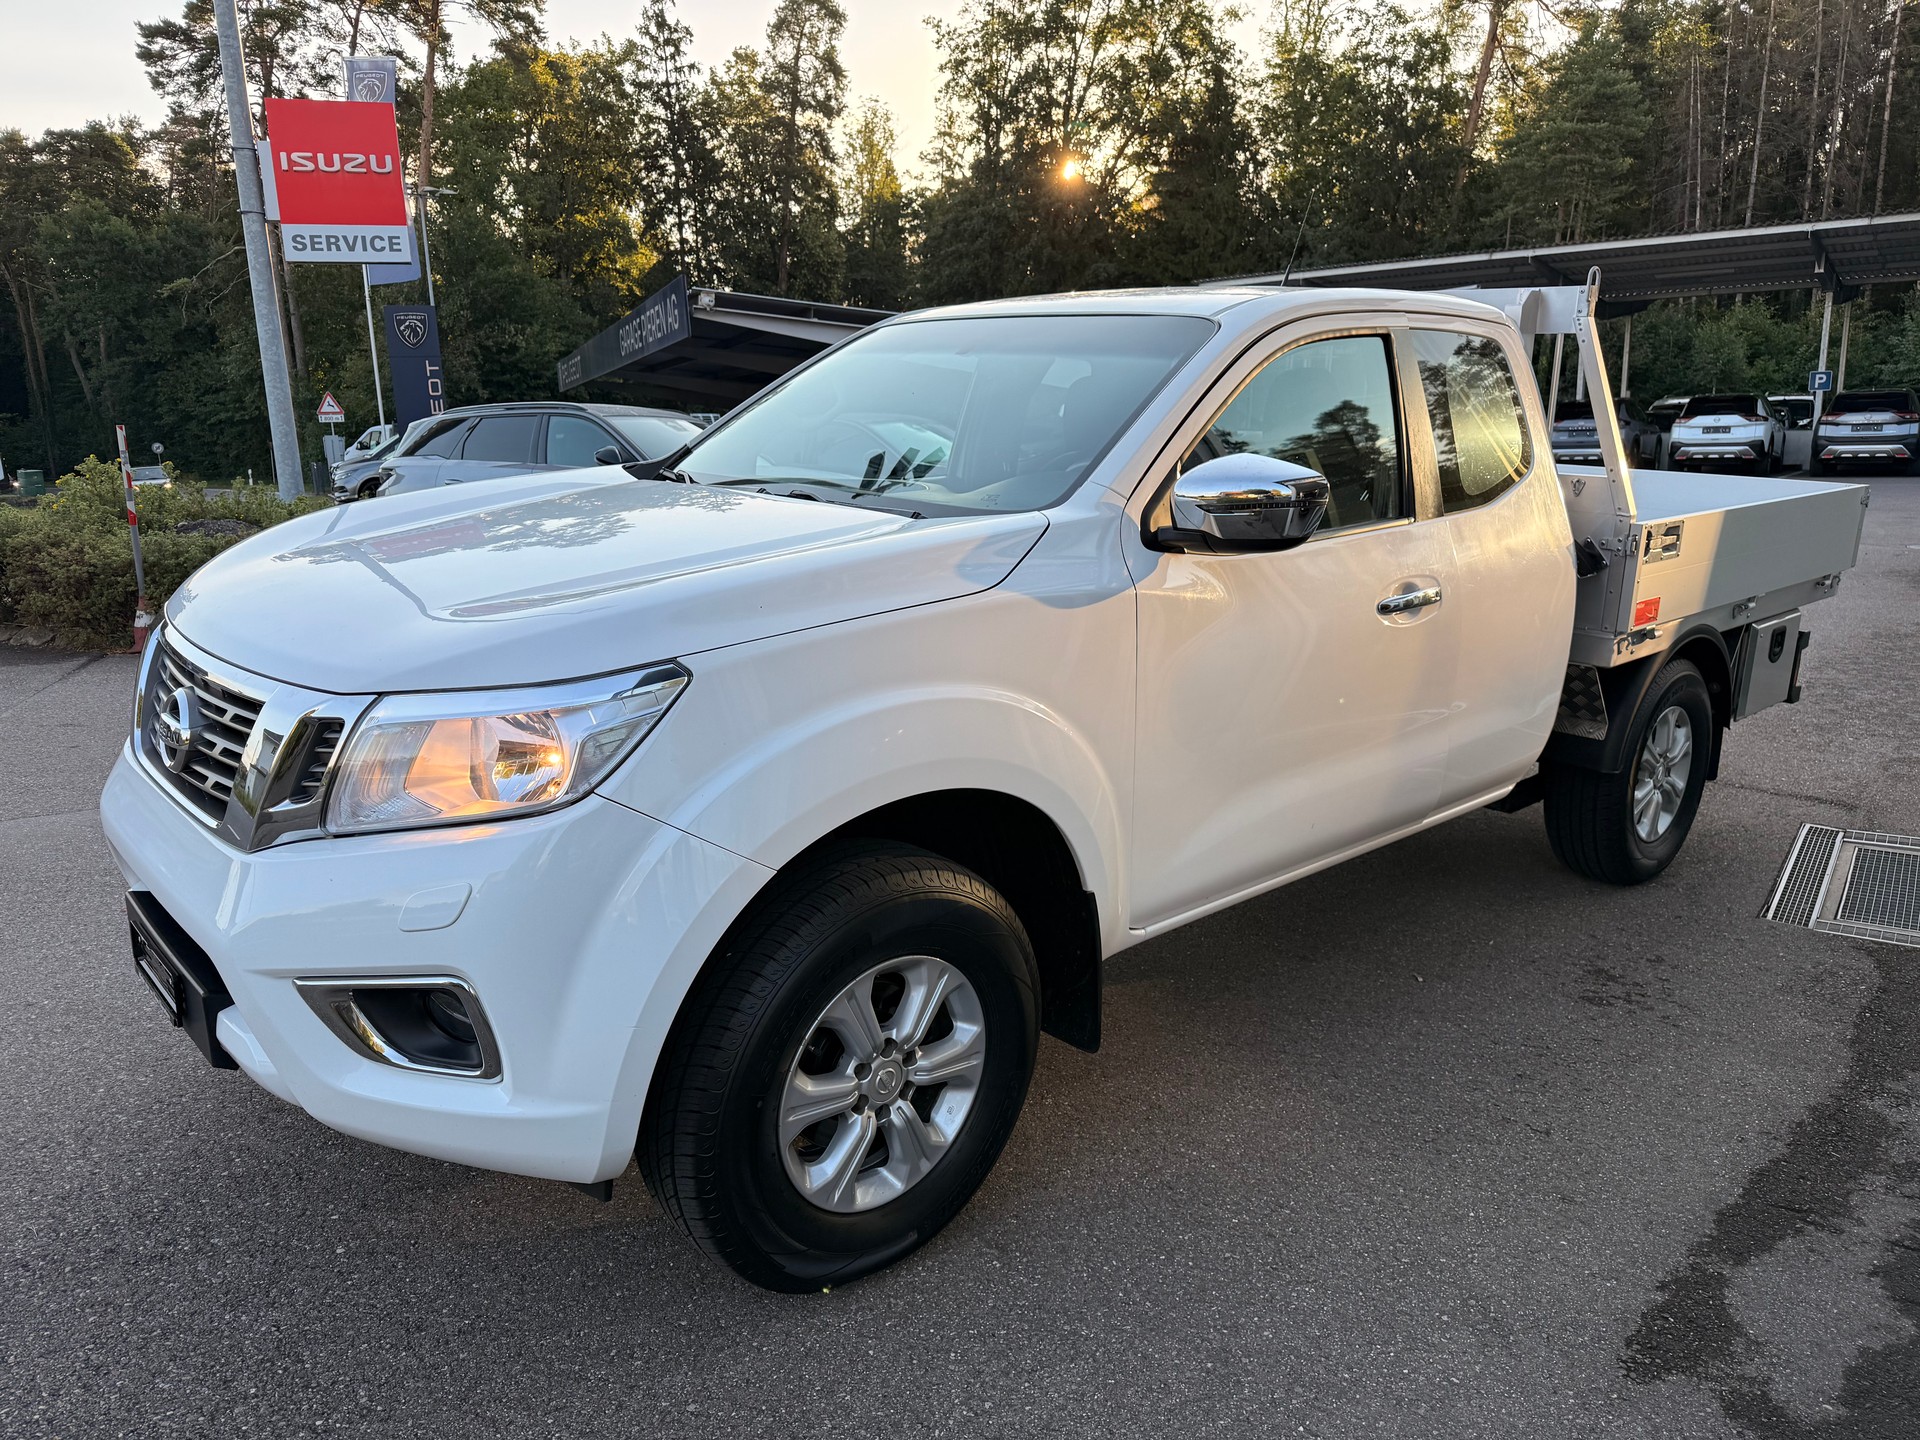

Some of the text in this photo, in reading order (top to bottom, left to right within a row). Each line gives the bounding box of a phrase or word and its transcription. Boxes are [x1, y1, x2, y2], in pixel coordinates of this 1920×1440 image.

[279, 151, 393, 174] ISUZU
[291, 234, 402, 253] SERVICE
[619, 293, 679, 357] GARAGE PIEREN AG
[1815, 374, 1826, 388] P
